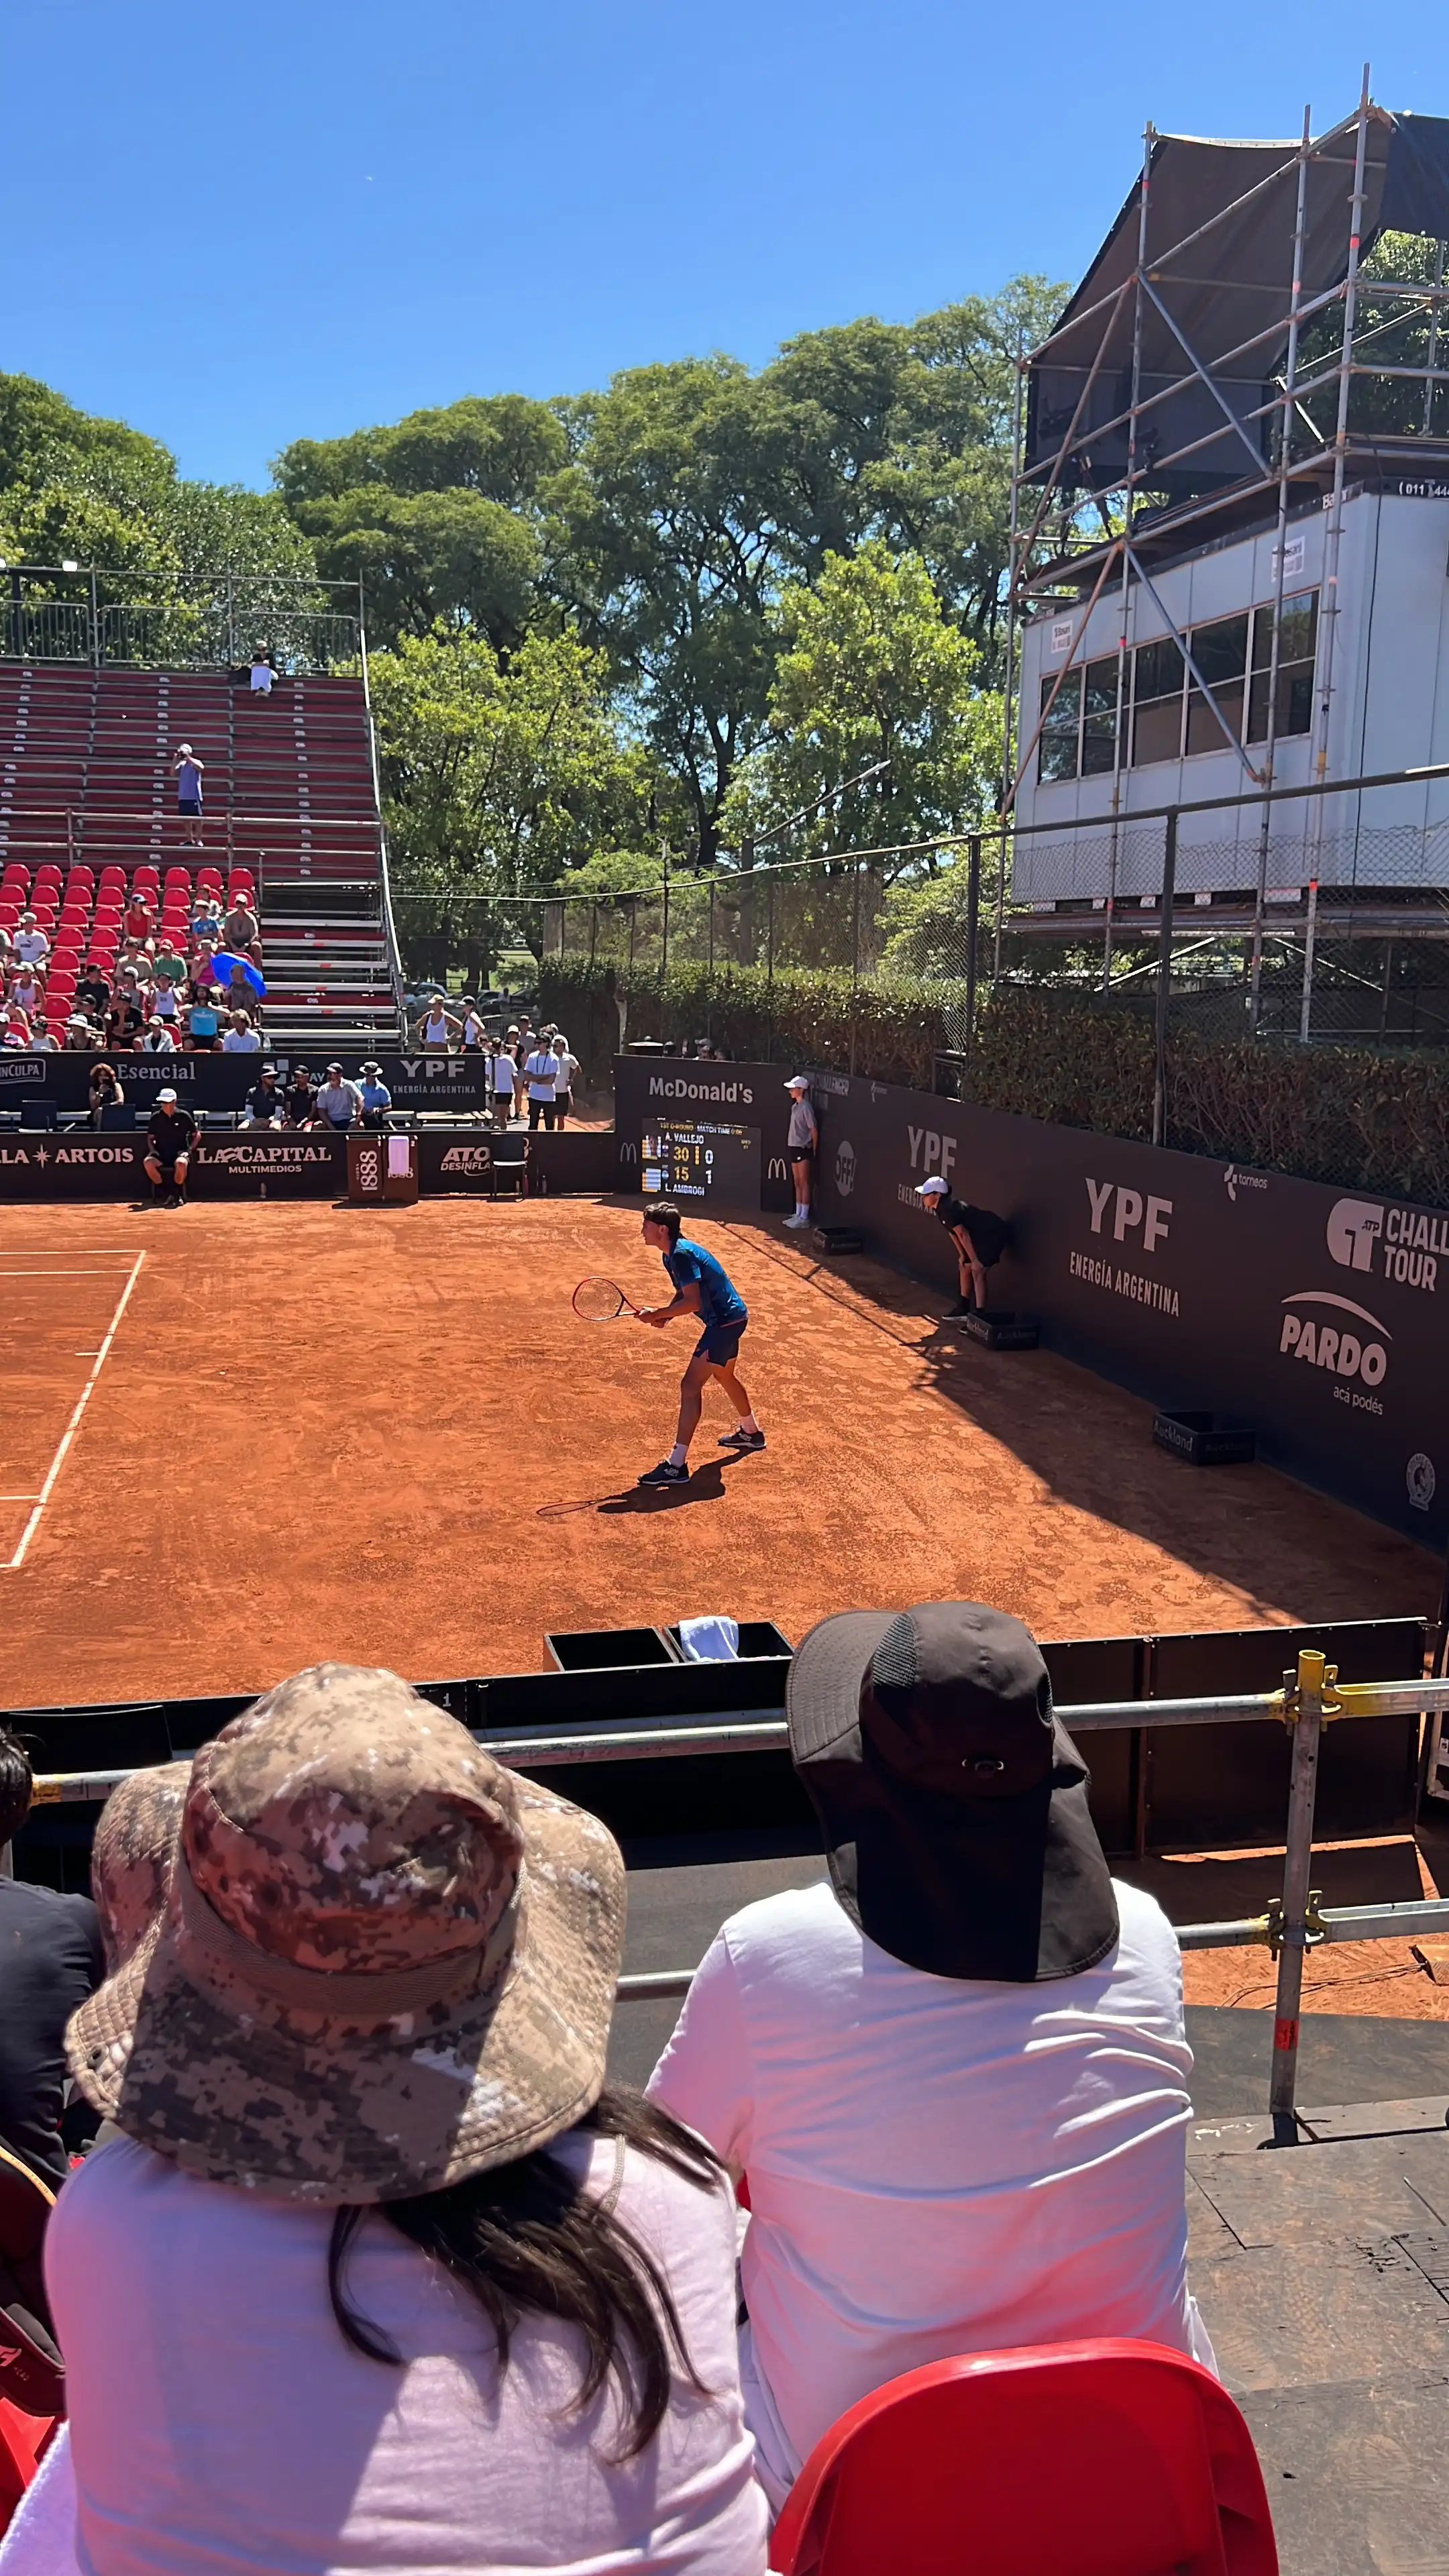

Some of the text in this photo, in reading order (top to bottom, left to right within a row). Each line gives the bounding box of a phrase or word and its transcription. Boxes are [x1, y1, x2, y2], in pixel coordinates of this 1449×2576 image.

[116, 1061, 196, 1080] Esencial
[400, 1060, 466, 1077] YPF
[393, 1084, 476, 1093] ENERGÍA ARGENTINA
[649, 1077, 753, 1104] McDonald's
[697, 1125, 716, 1133] MATCH
[674, 1132, 704, 1144] VALLEJO
[0, 1148, 133, 1164] LA ARTOIS
[197, 1146, 332, 1164] LA CAPITAL
[442, 1146, 490, 1162] ATO
[673, 1146, 714, 1165] 30 0
[908, 1125, 957, 1179] YPF
[228, 1165, 302, 1174] MULTIMEDIOS
[359, 1150, 378, 1191] 1888
[440, 1161, 493, 1171] DESINFLA
[674, 1167, 712, 1184] 15 1
[1238, 1175, 1268, 1189] torneos
[672, 1185, 705, 1196] AMBROGI
[1085, 1177, 1173, 1252] YPF
[1361, 1219, 1380, 1232] ATP
[1386, 1208, 1449, 1257] CHALL
[1384, 1244, 1437, 1292] TOUR
[1069, 1251, 1179, 1317] ENERGÍA ARGENTINA
[1279, 1313, 1387, 1387] PARDO
[1333, 1385, 1384, 1415] acá podés
[1153, 1419, 1193, 1452] Auckland
[443, 1693, 451, 1707] 1
